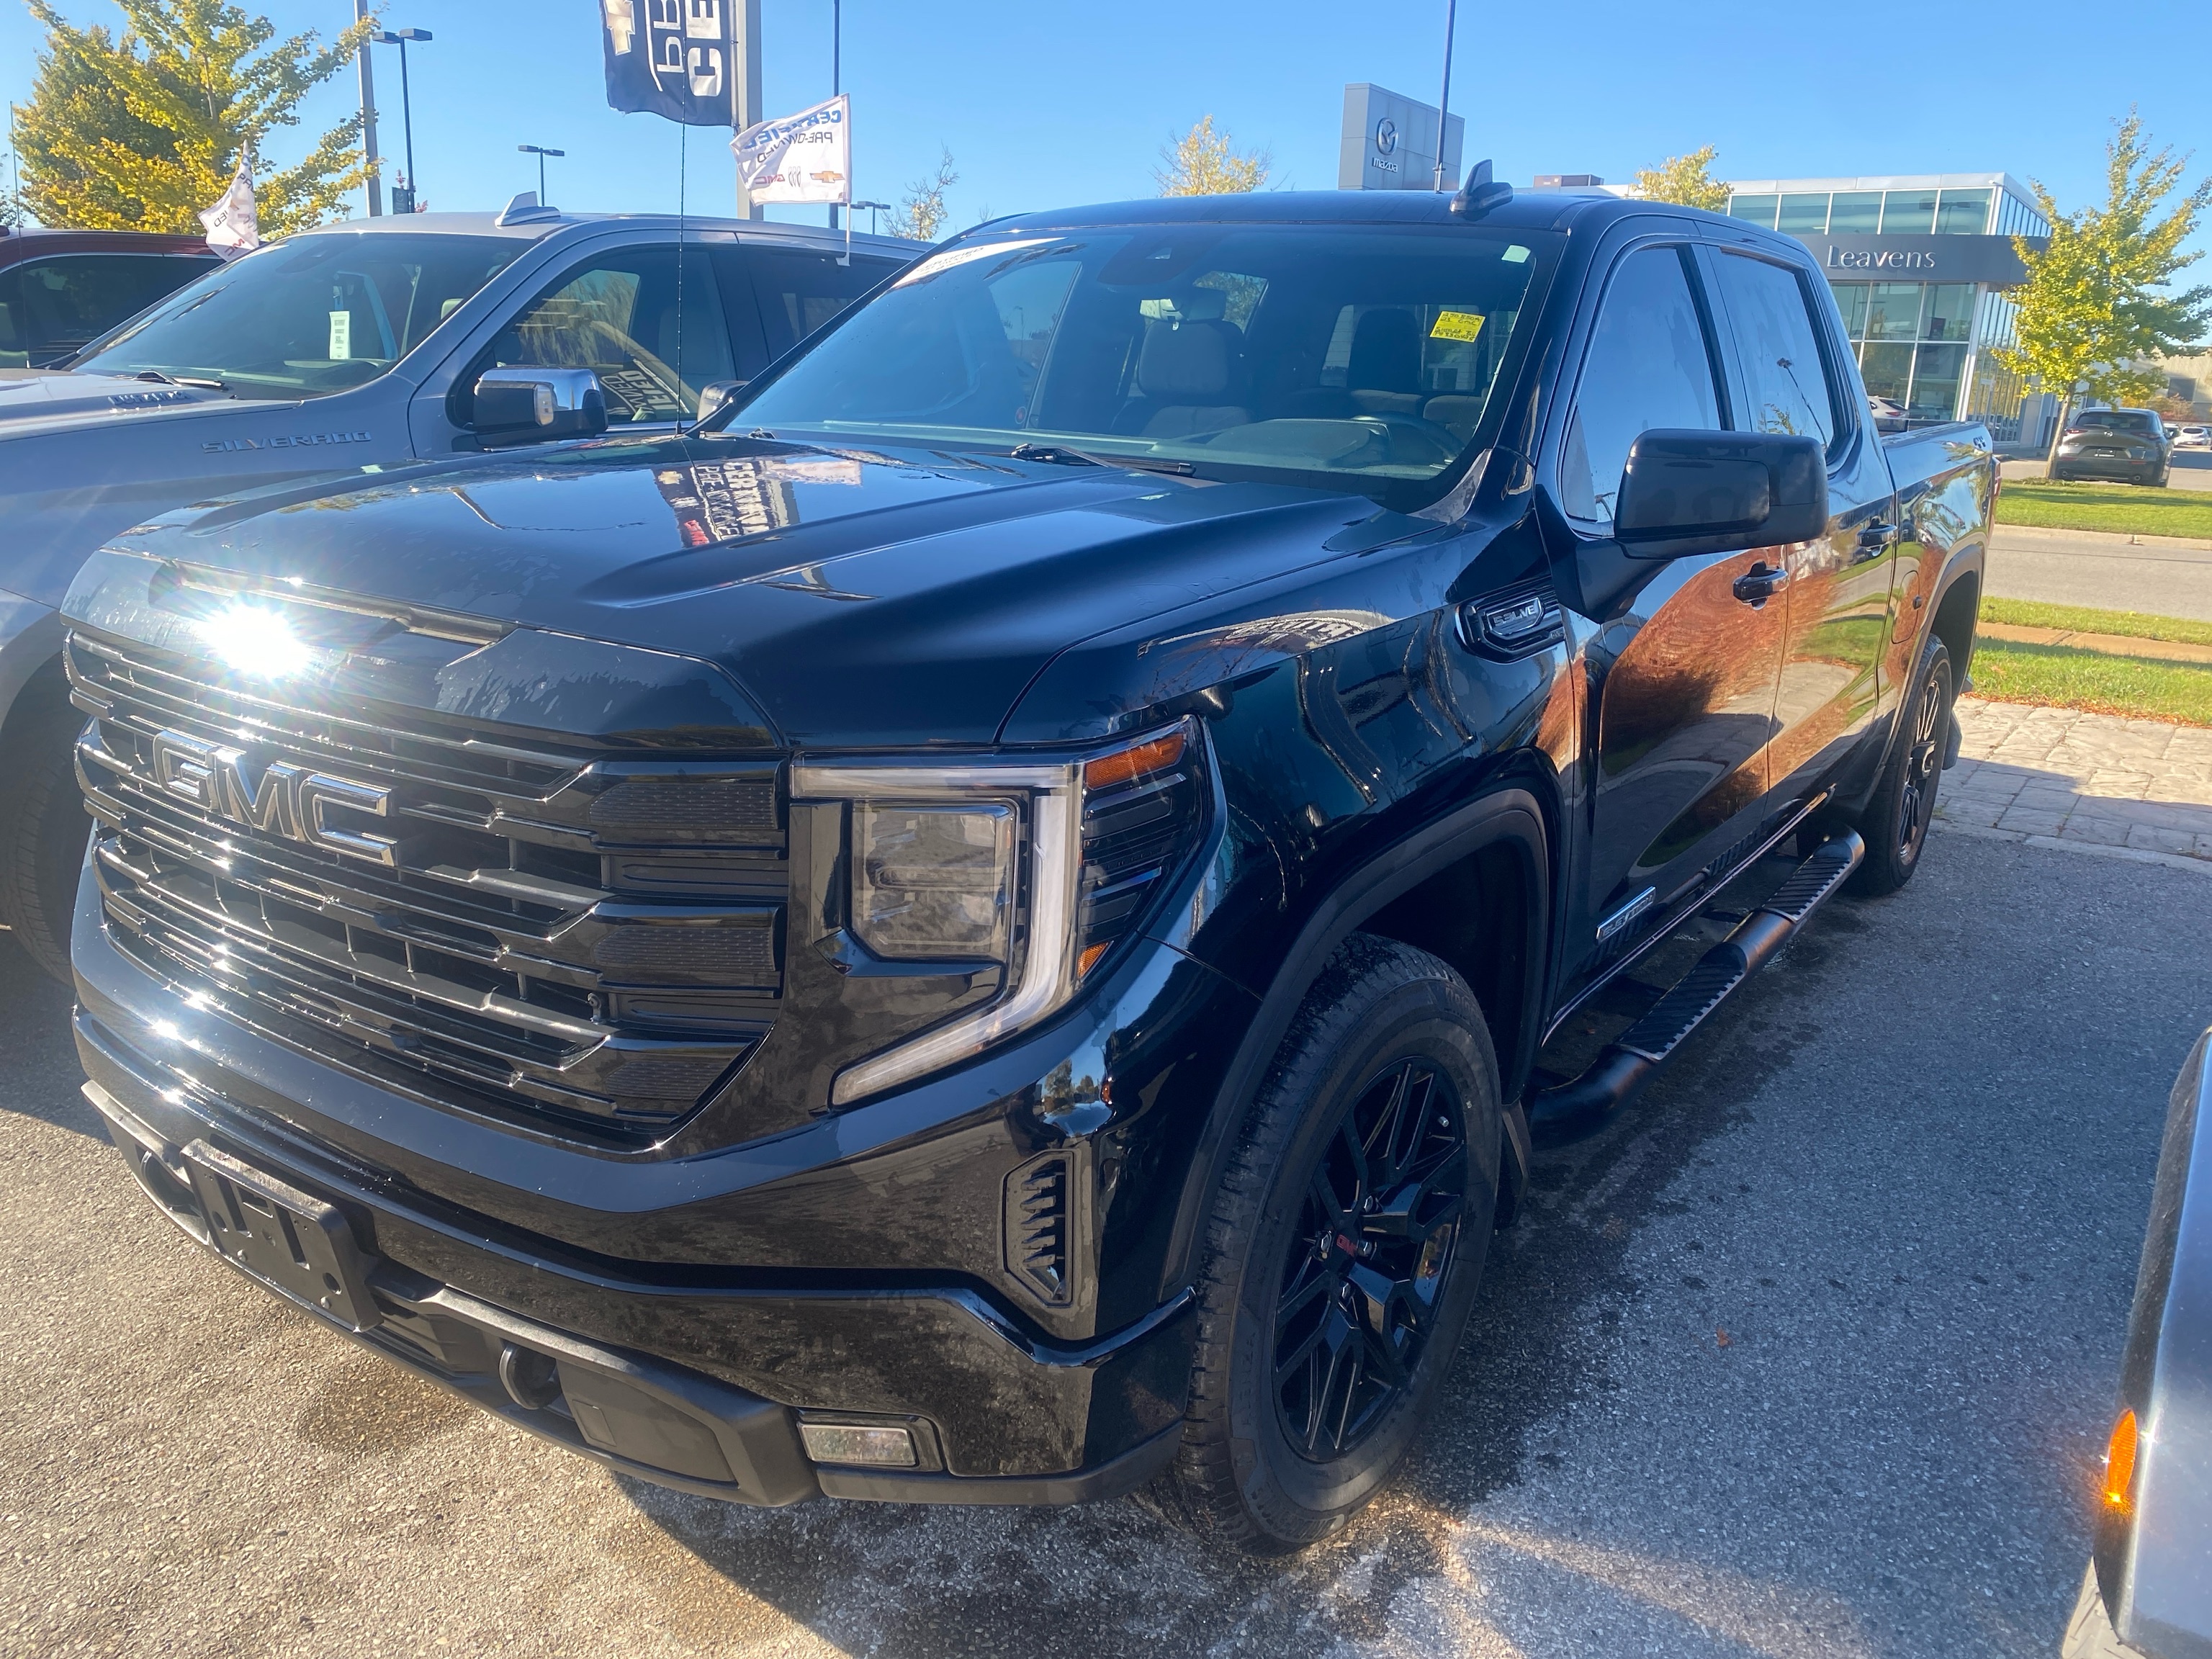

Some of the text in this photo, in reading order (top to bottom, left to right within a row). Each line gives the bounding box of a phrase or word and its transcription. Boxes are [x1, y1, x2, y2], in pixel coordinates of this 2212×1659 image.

[1827, 245, 1936, 269] Leavens
[201, 430, 372, 454] SILVERADO
[152, 729, 398, 866] GMC
